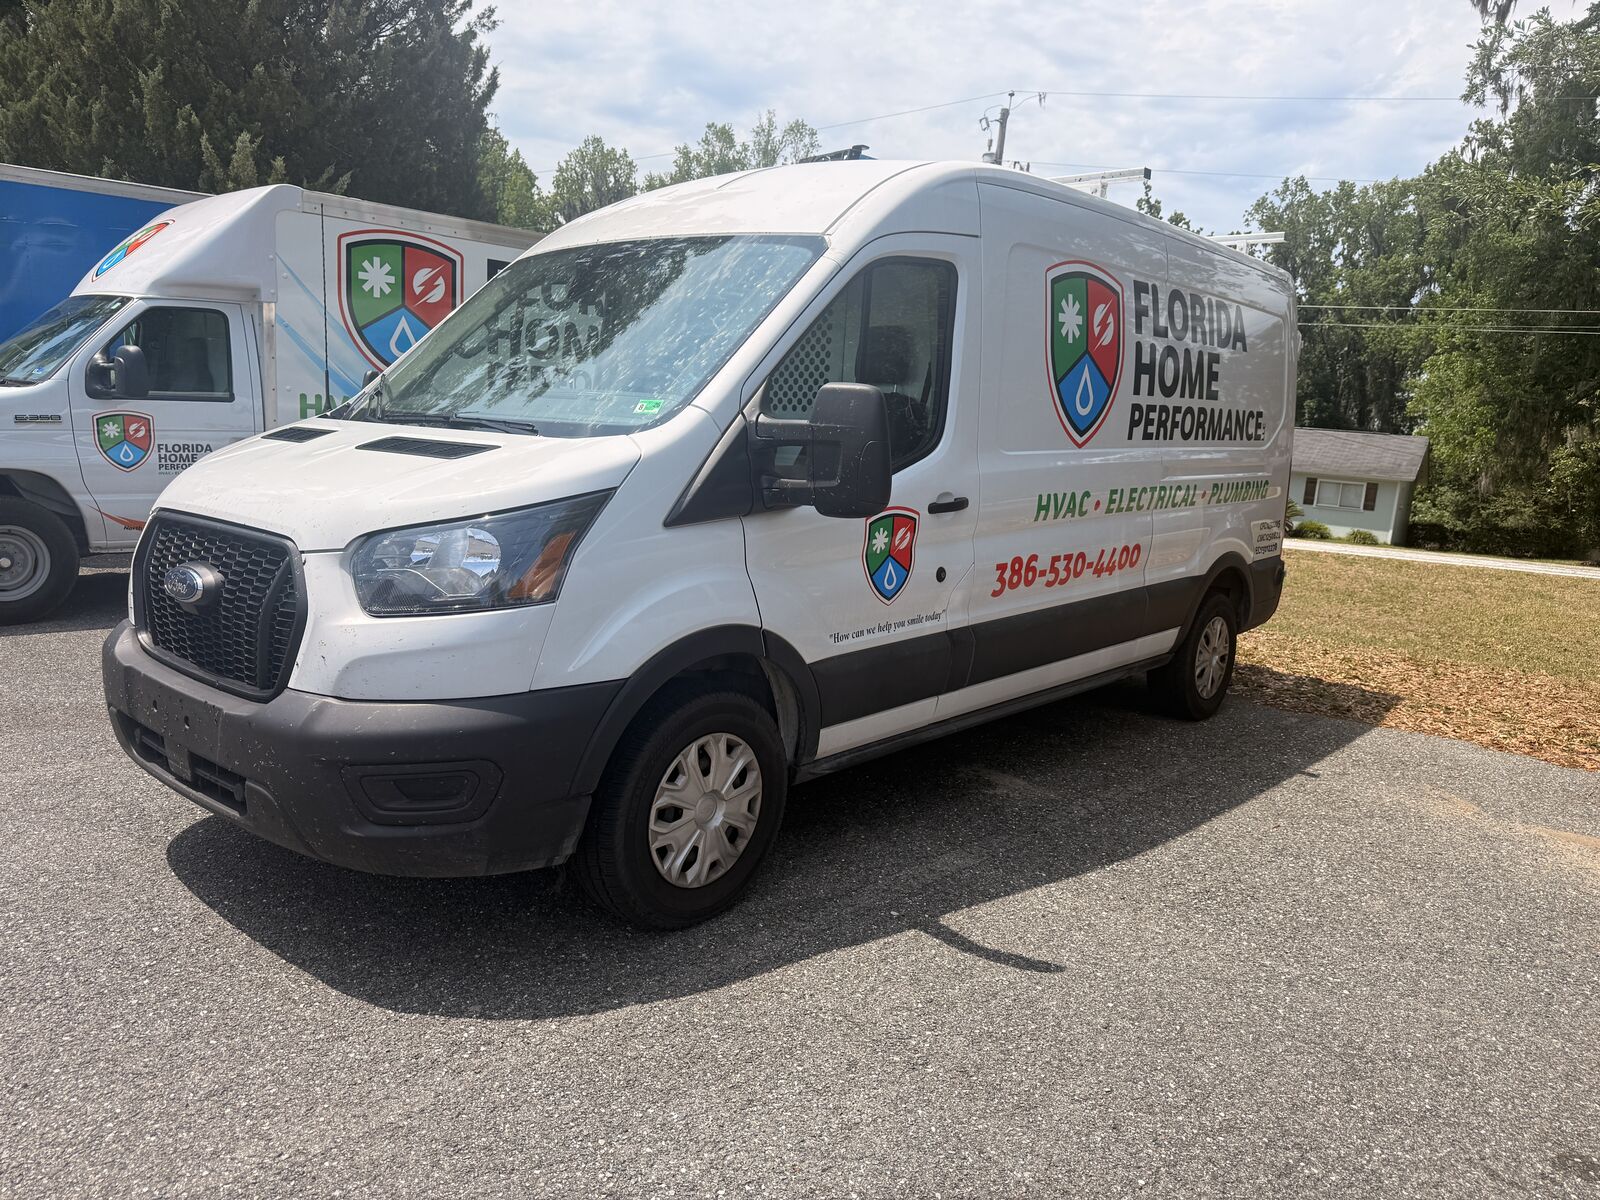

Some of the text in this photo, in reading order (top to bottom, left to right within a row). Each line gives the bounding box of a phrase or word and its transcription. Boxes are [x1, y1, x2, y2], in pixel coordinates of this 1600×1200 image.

[1133, 280, 1248, 352] FLORIDA
[1133, 341, 1221, 401] HOME
[1127, 403, 1264, 441] PERFORMANCE
[157, 443, 213, 453] FLORIDA
[158, 453, 199, 463] HOME
[1033, 479, 1270, 522] HVAC ELECTRICAL PLUMBING
[990, 543, 1142, 598] 386-530-4400
[851, 629, 865, 639] can
[866, 626, 876, 635] we
[877, 621, 892, 633] help
[893, 620, 906, 632] you
[907, 614, 924, 626] smile
